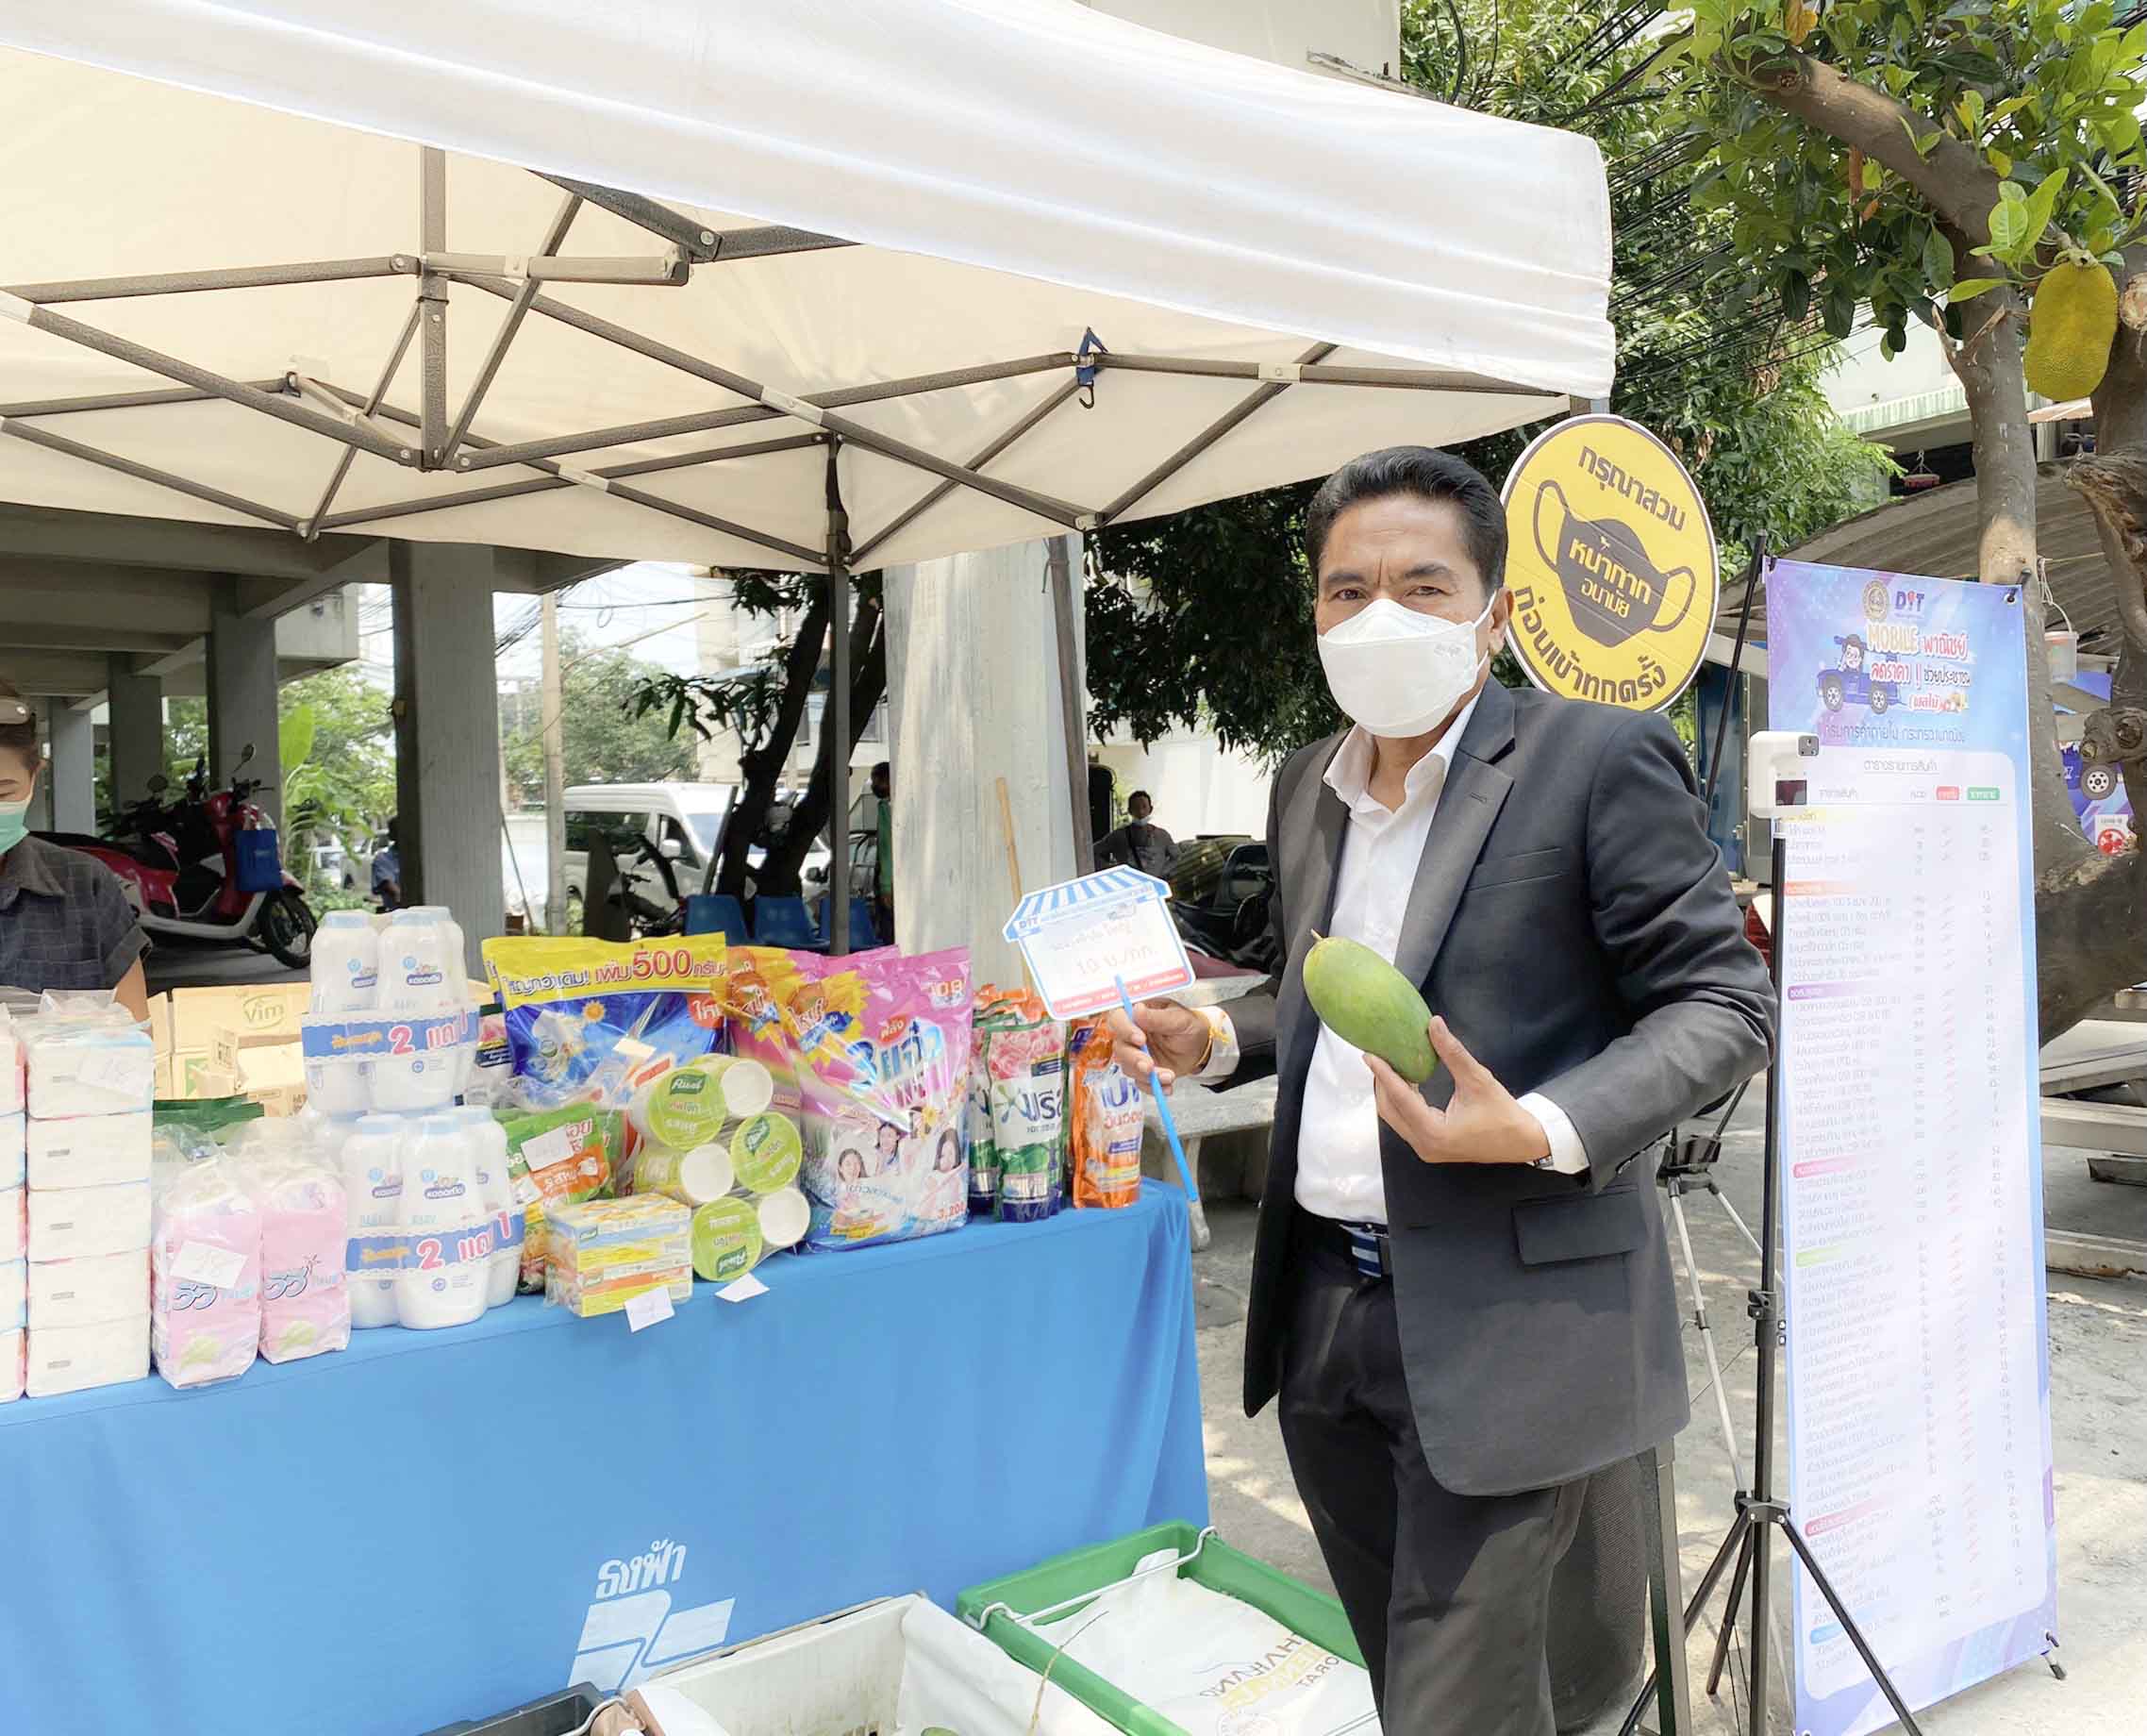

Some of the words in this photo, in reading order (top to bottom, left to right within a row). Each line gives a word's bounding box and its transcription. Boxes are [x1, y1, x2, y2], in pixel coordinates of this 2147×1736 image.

[1578, 446, 1686, 531] กรุณาสวม
[1570, 536, 1652, 604] หน้ากาก
[1581, 578, 1630, 619] อนามัย
[1867, 625, 1918, 651] MOBILE
[633, 949, 693, 981] 500
[390, 1026, 415, 1056] 2
[417, 1239, 444, 1270] 2
[497, 1210, 511, 1239] 1
[595, 1538, 688, 1599] ธงฟ้า
